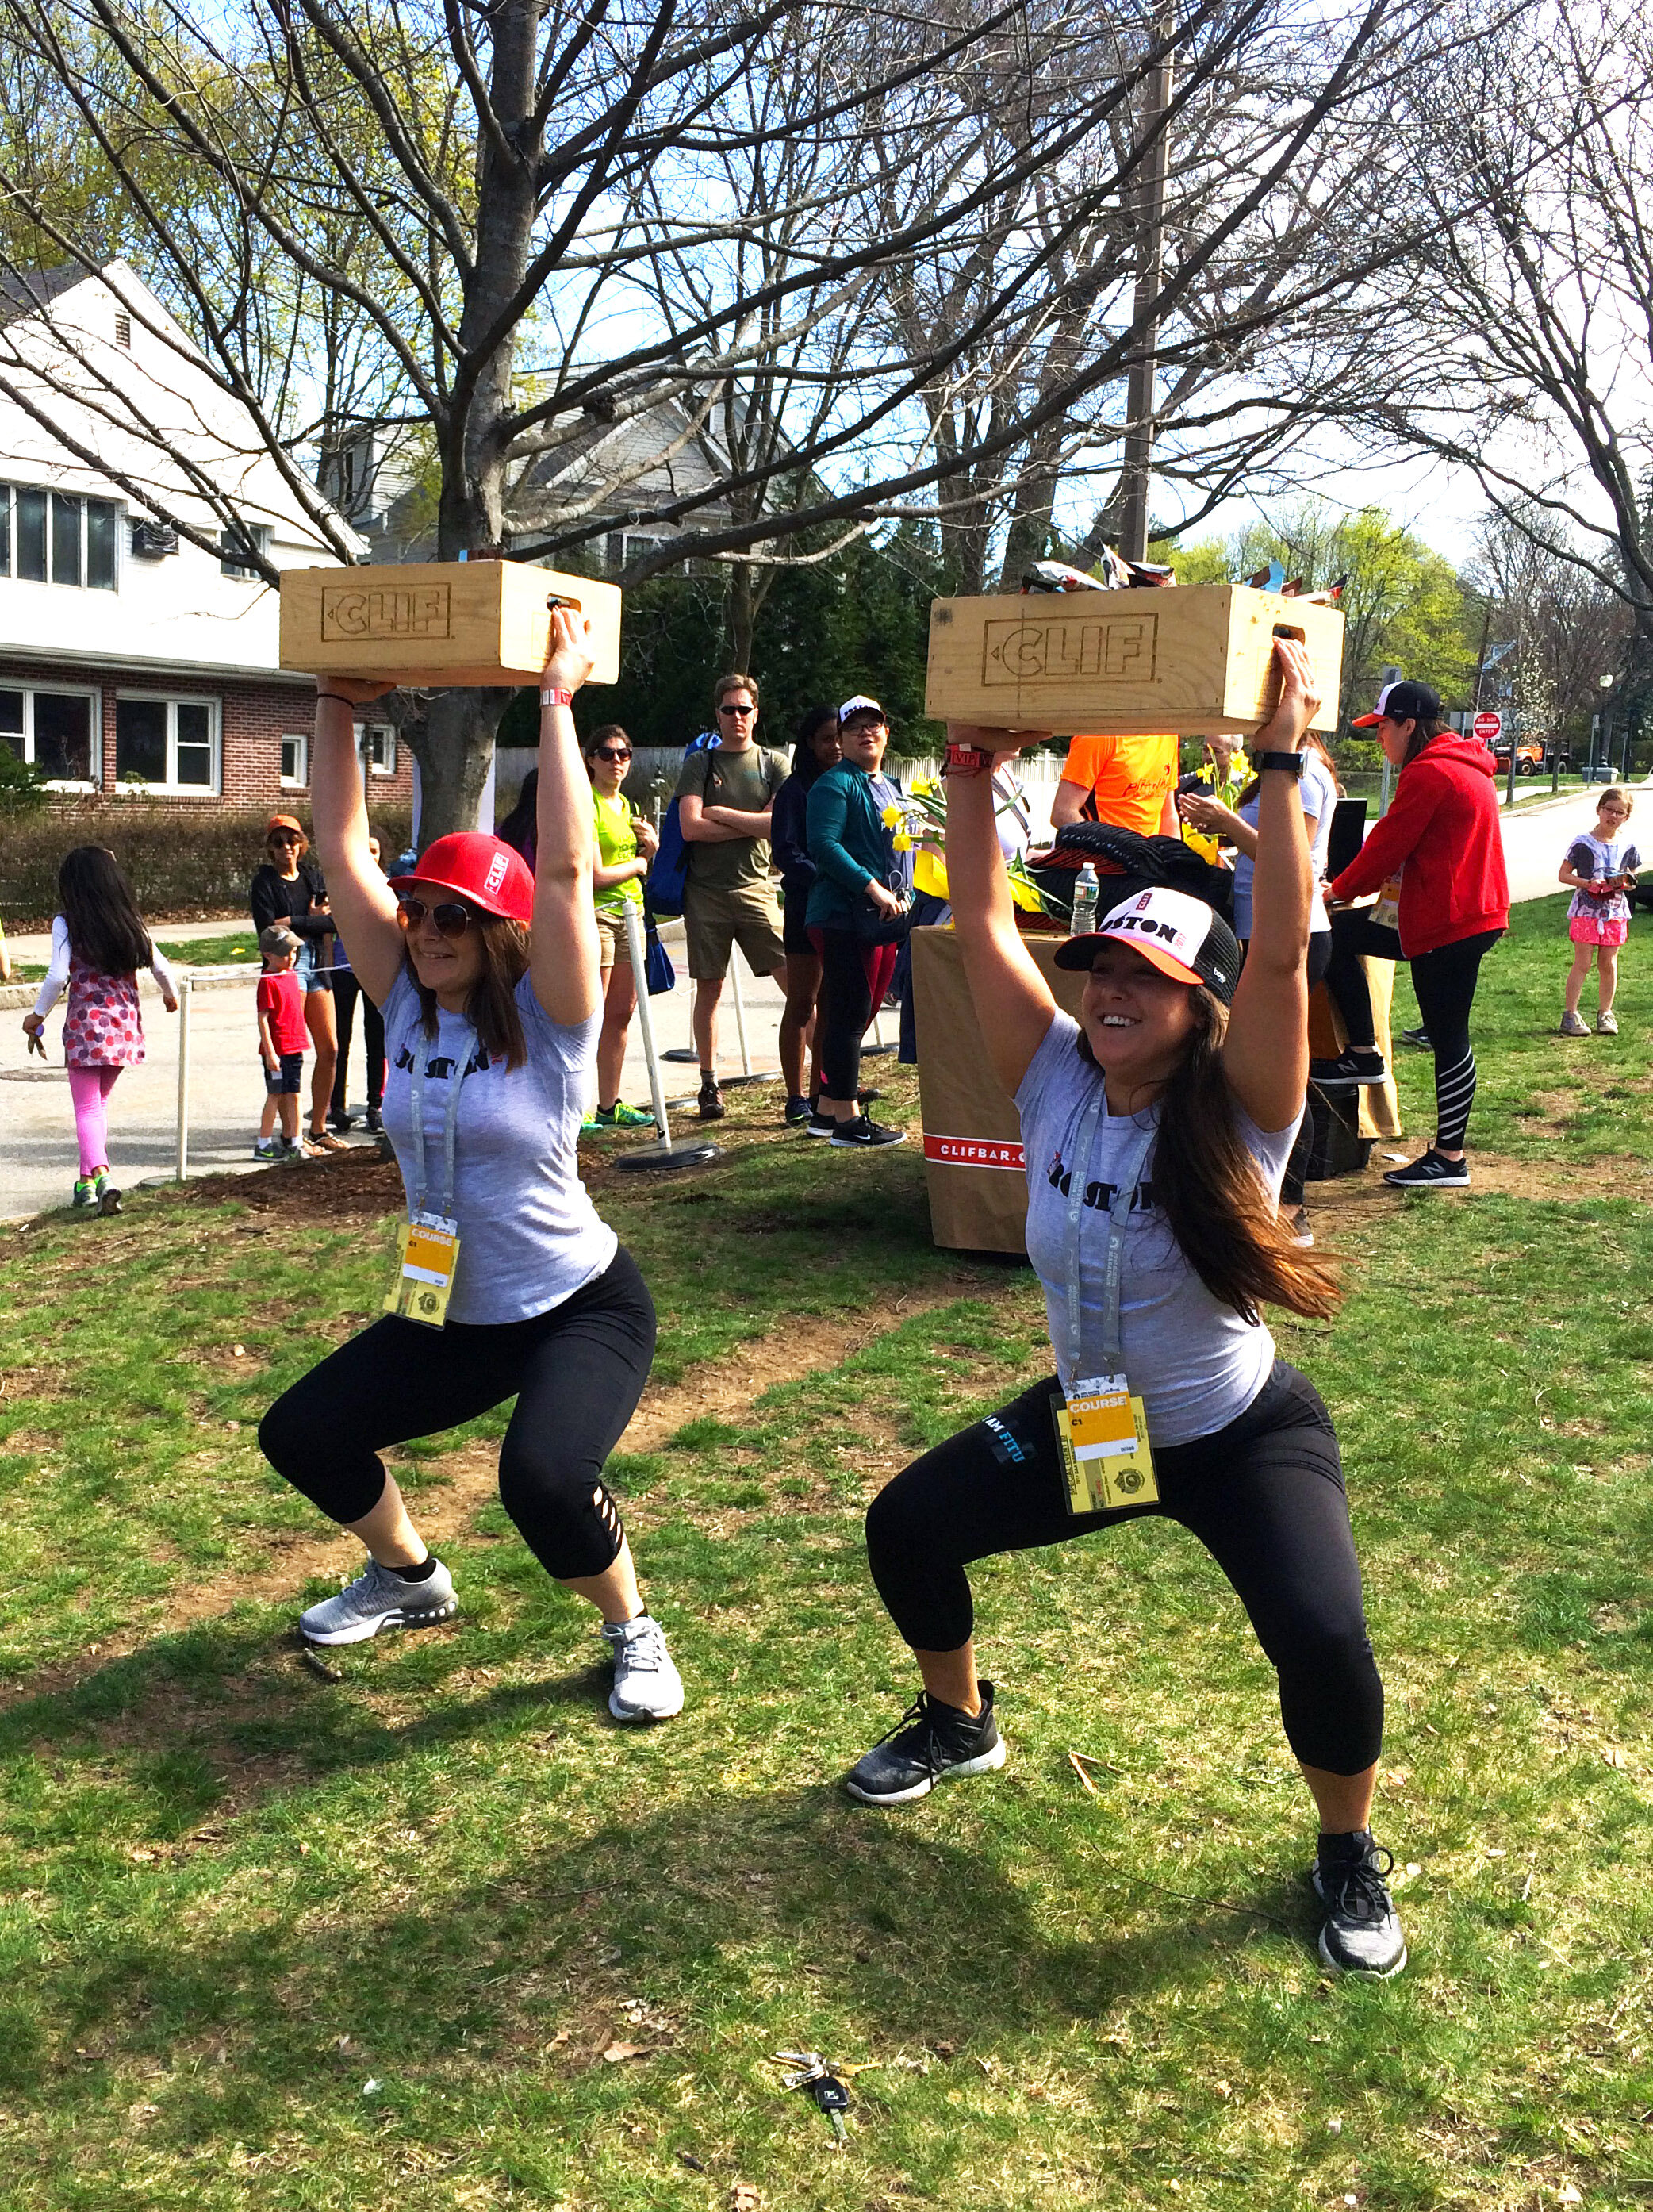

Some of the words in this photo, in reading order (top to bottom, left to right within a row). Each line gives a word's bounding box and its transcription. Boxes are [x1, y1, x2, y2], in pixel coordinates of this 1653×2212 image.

[336, 591, 440, 634] CLIF
[1002, 624, 1144, 677] CLIF
[955, 753, 975, 763] VIP
[489, 856, 507, 887] CLIF
[412, 1228, 453, 1246] COURSE
[1069, 1396, 1127, 1413] COURSE
[985, 1417, 1005, 1432] AM
